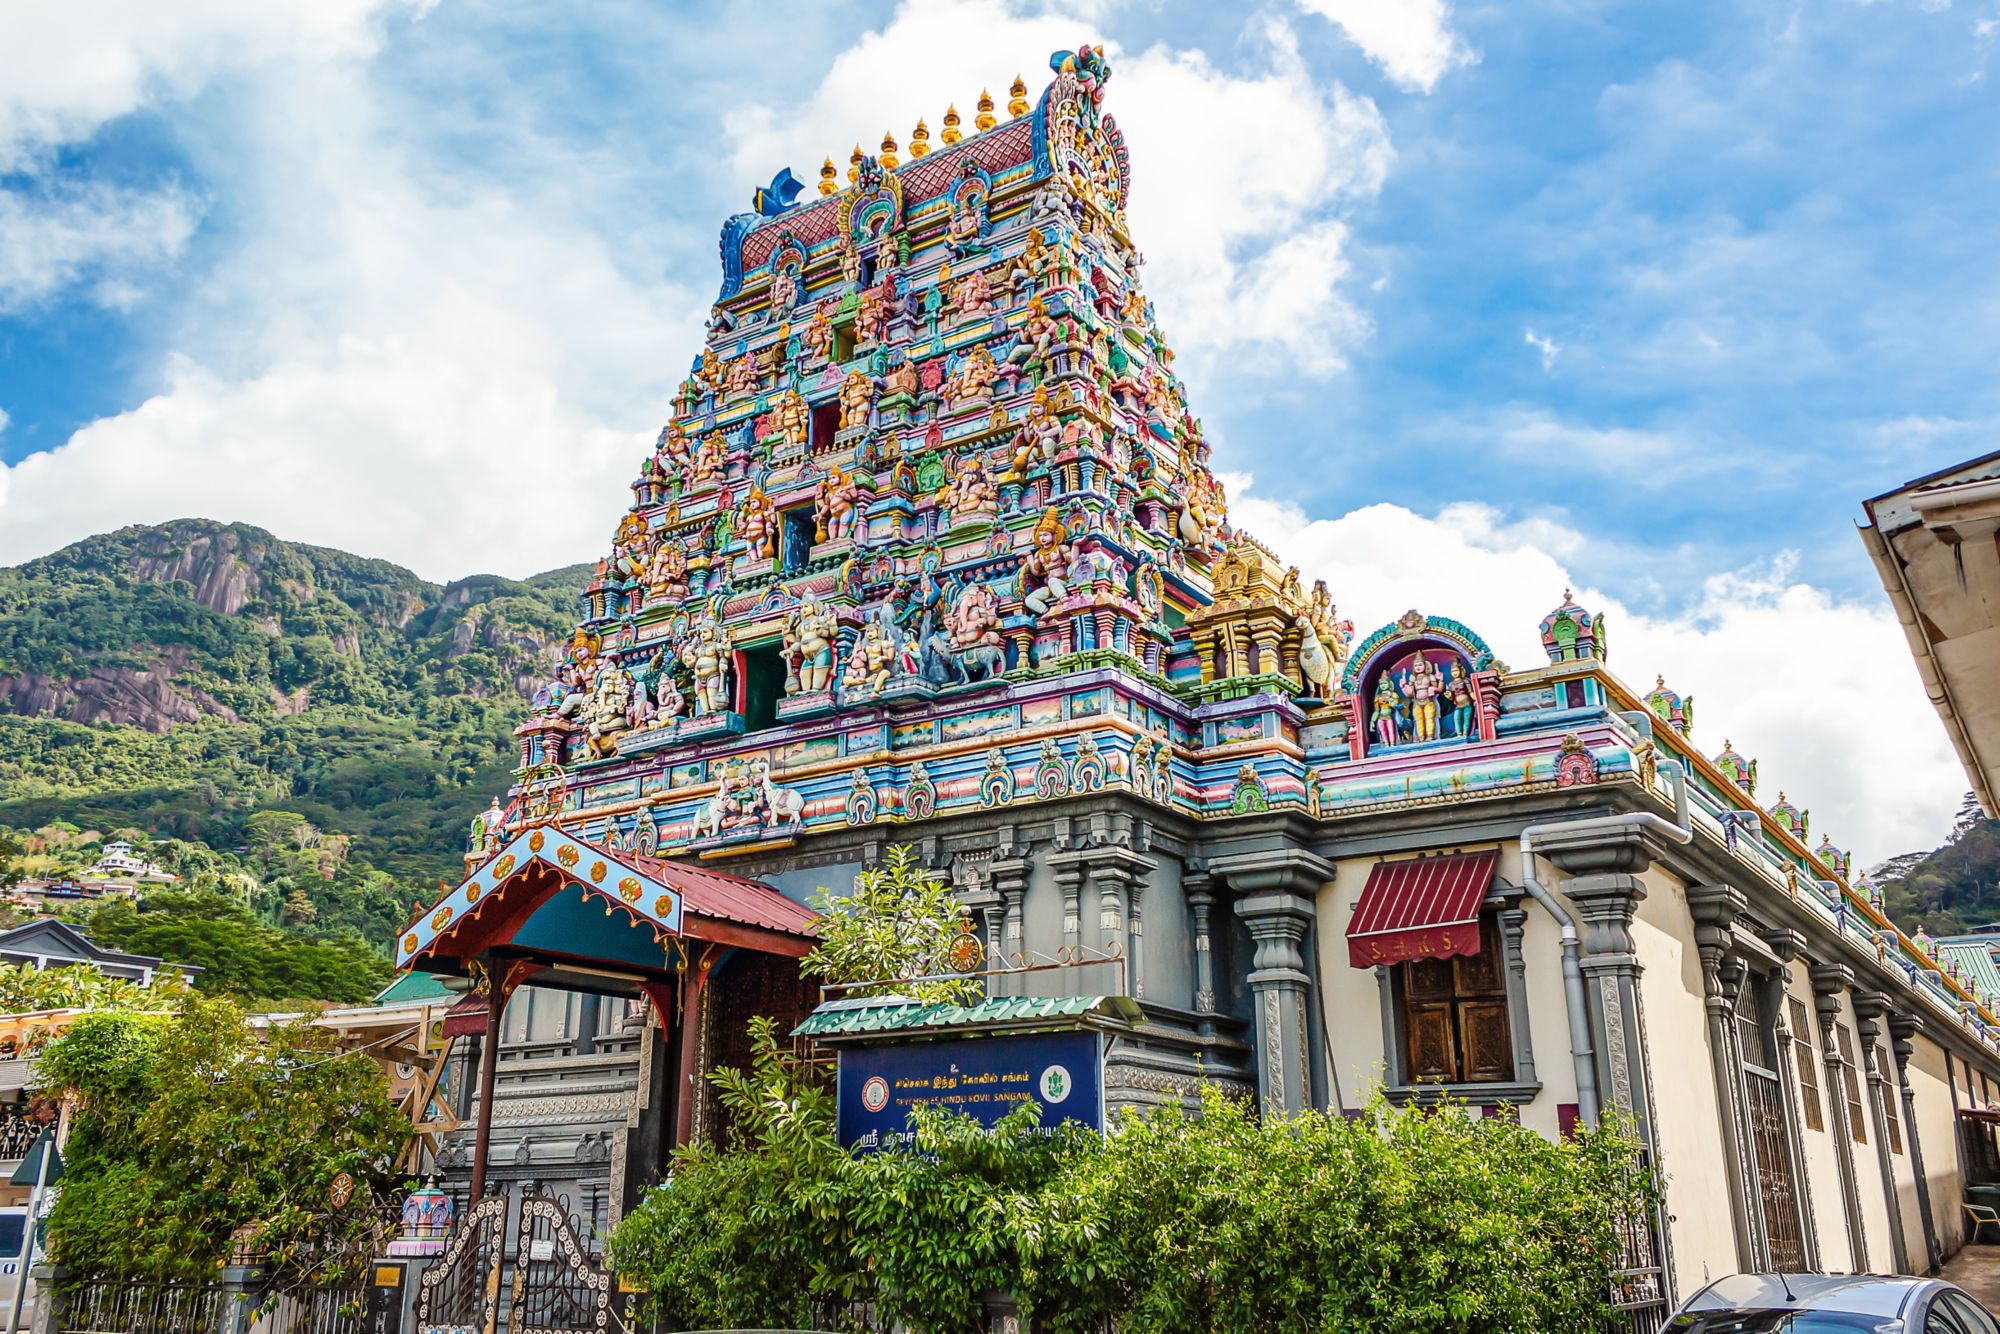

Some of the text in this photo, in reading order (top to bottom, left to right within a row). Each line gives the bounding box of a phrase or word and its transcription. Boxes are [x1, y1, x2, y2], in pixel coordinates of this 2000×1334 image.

[933, 1075, 957, 1089] இந்து
[941, 1095, 966, 1105] HINDU
[993, 1091, 1031, 1102] SANGAM
